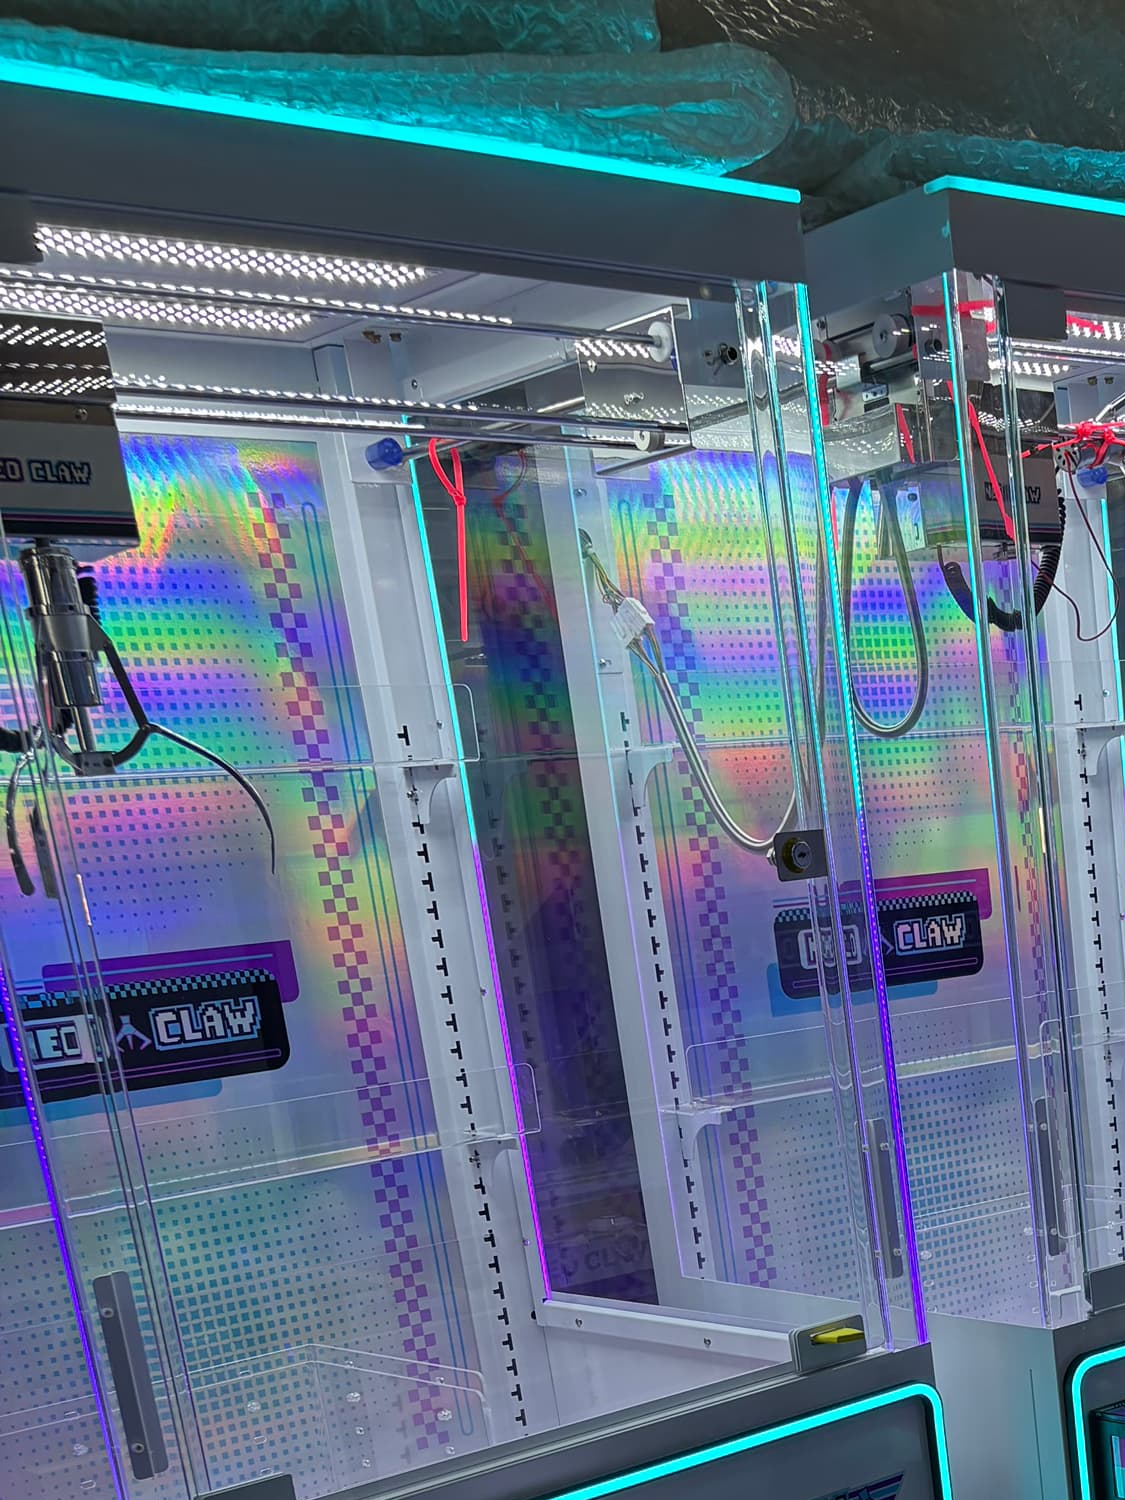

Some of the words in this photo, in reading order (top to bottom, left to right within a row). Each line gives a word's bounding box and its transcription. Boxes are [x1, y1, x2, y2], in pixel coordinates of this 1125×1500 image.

[30, 461, 89, 483] CLAW
[896, 916, 962, 951] CLAW
[154, 999, 256, 1046] CLAW
